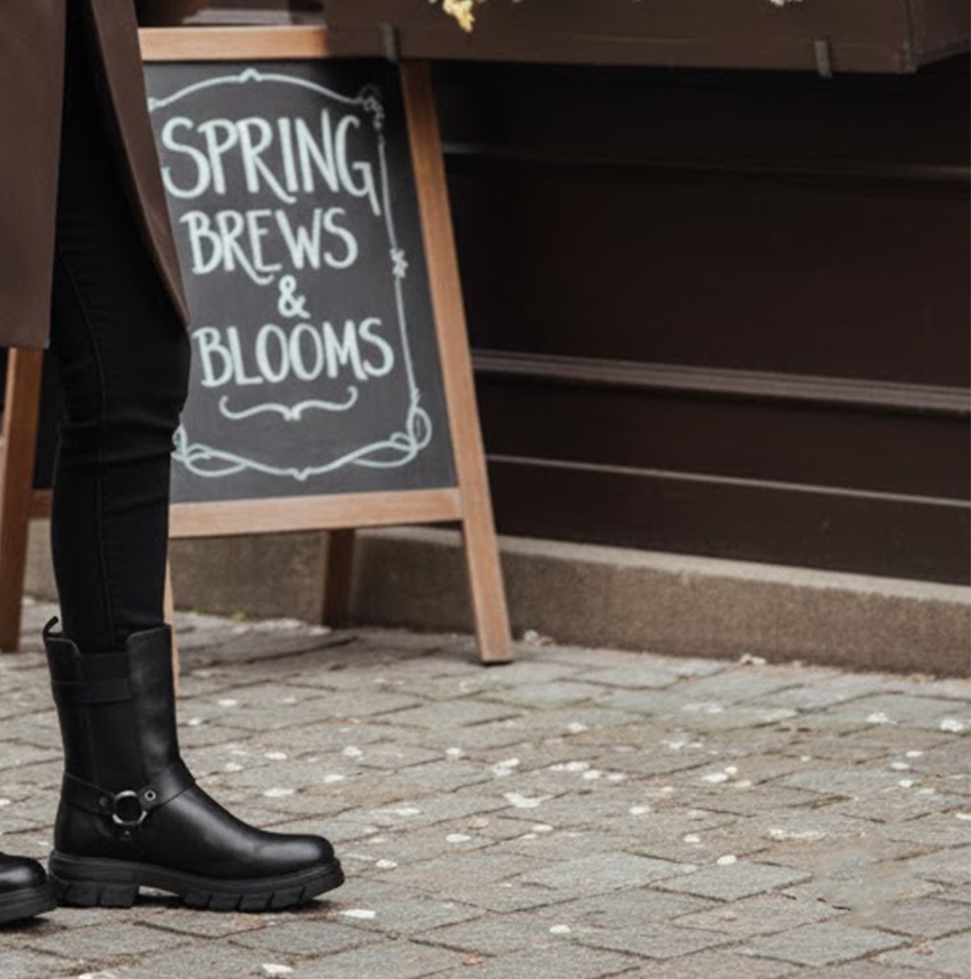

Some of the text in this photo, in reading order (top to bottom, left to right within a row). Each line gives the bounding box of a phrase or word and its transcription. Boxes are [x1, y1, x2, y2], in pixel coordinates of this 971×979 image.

[161, 109, 381, 216] SPRING
[179, 207, 359, 285] BREWS
[277, 274, 312, 320] &
[192, 317, 395, 389] BLOOMS
